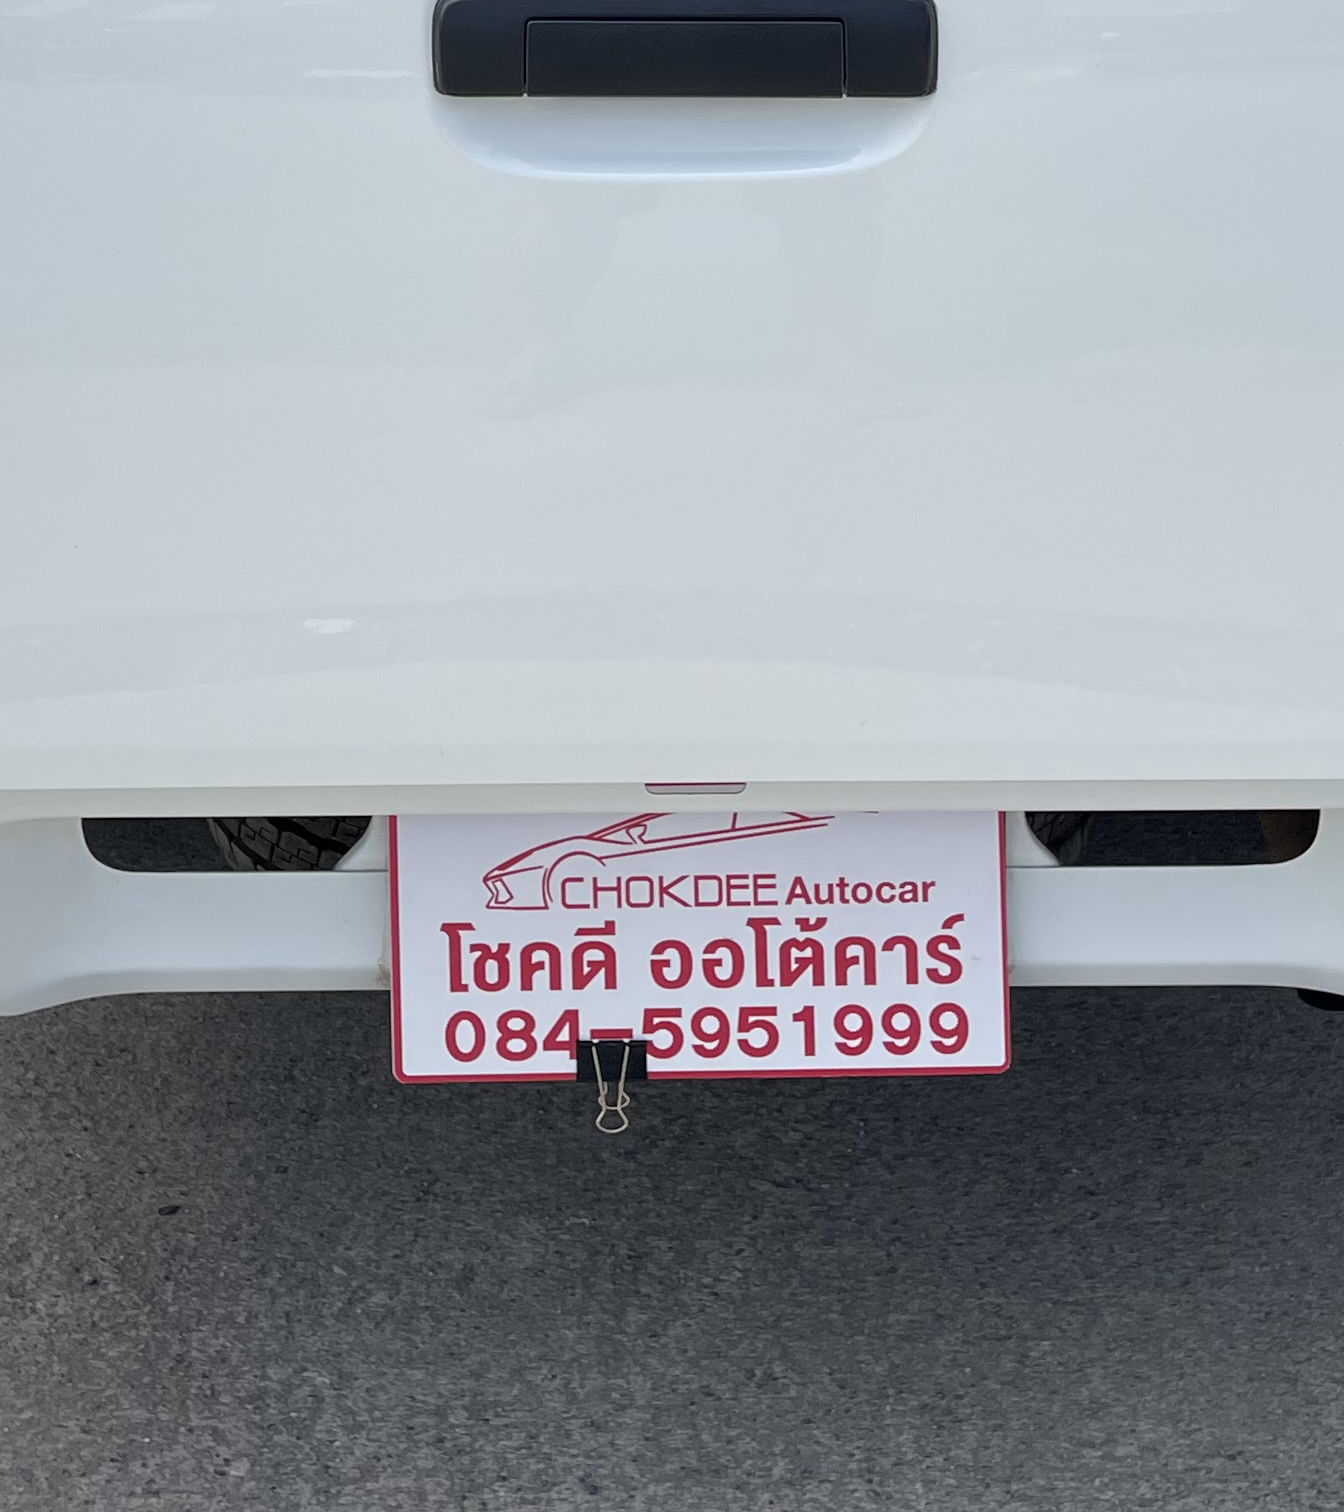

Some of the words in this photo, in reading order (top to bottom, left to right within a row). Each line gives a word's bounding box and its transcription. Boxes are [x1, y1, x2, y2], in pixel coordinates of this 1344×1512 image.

[560, 874, 778, 909] CHOKDEE
[785, 876, 935, 906] Autocar
[439, 920, 616, 993] โชคดี
[650, 913, 965, 989] ออโต้คาร์
[444, 1002, 970, 1062] 084-5951999
